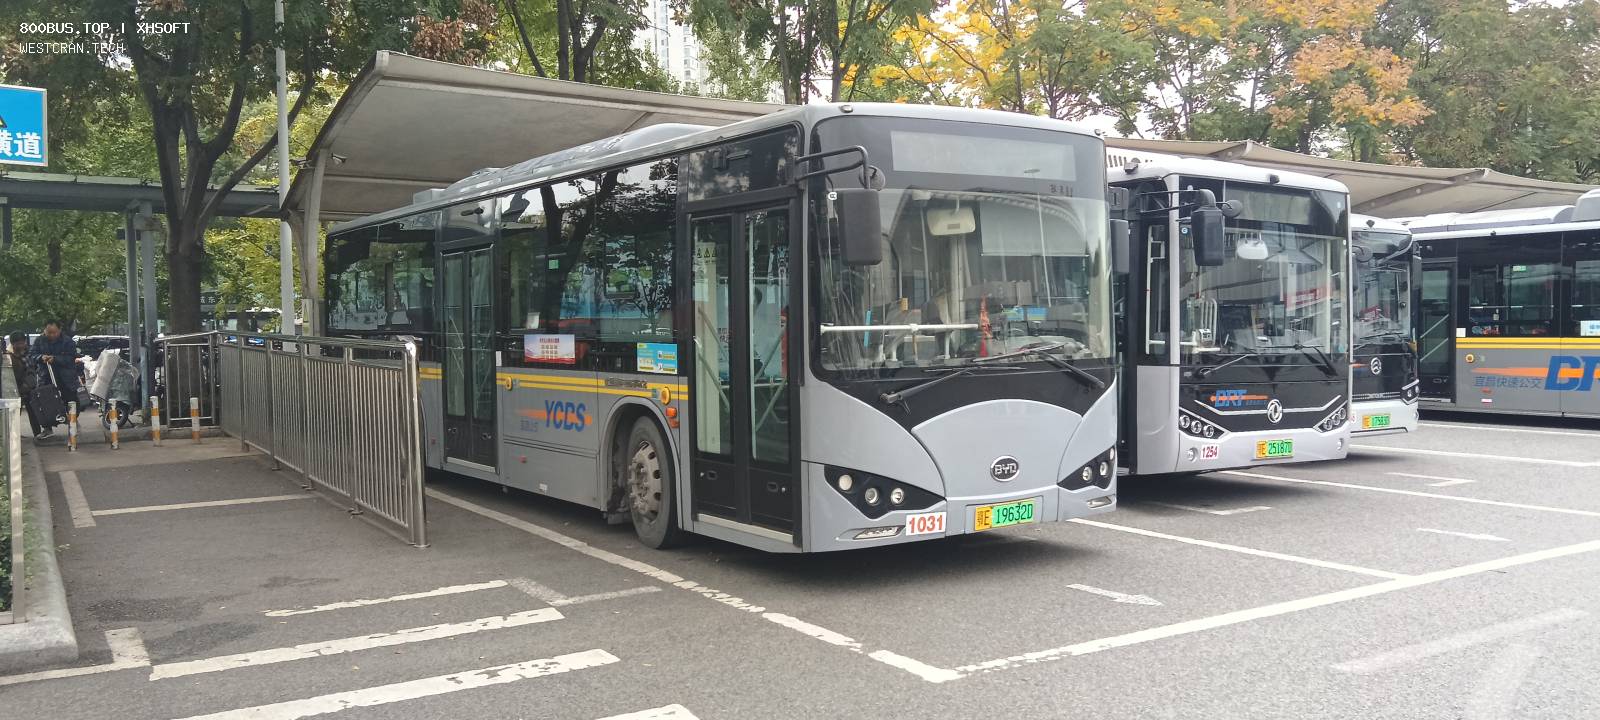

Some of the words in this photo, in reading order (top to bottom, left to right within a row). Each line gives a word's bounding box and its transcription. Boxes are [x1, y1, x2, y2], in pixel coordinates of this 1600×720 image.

[1202, 446, 1218, 459] 1254
[994, 462, 1016, 475] BYD
[996, 503, 1033, 524] 19632D
[909, 515, 943, 534] 1031
